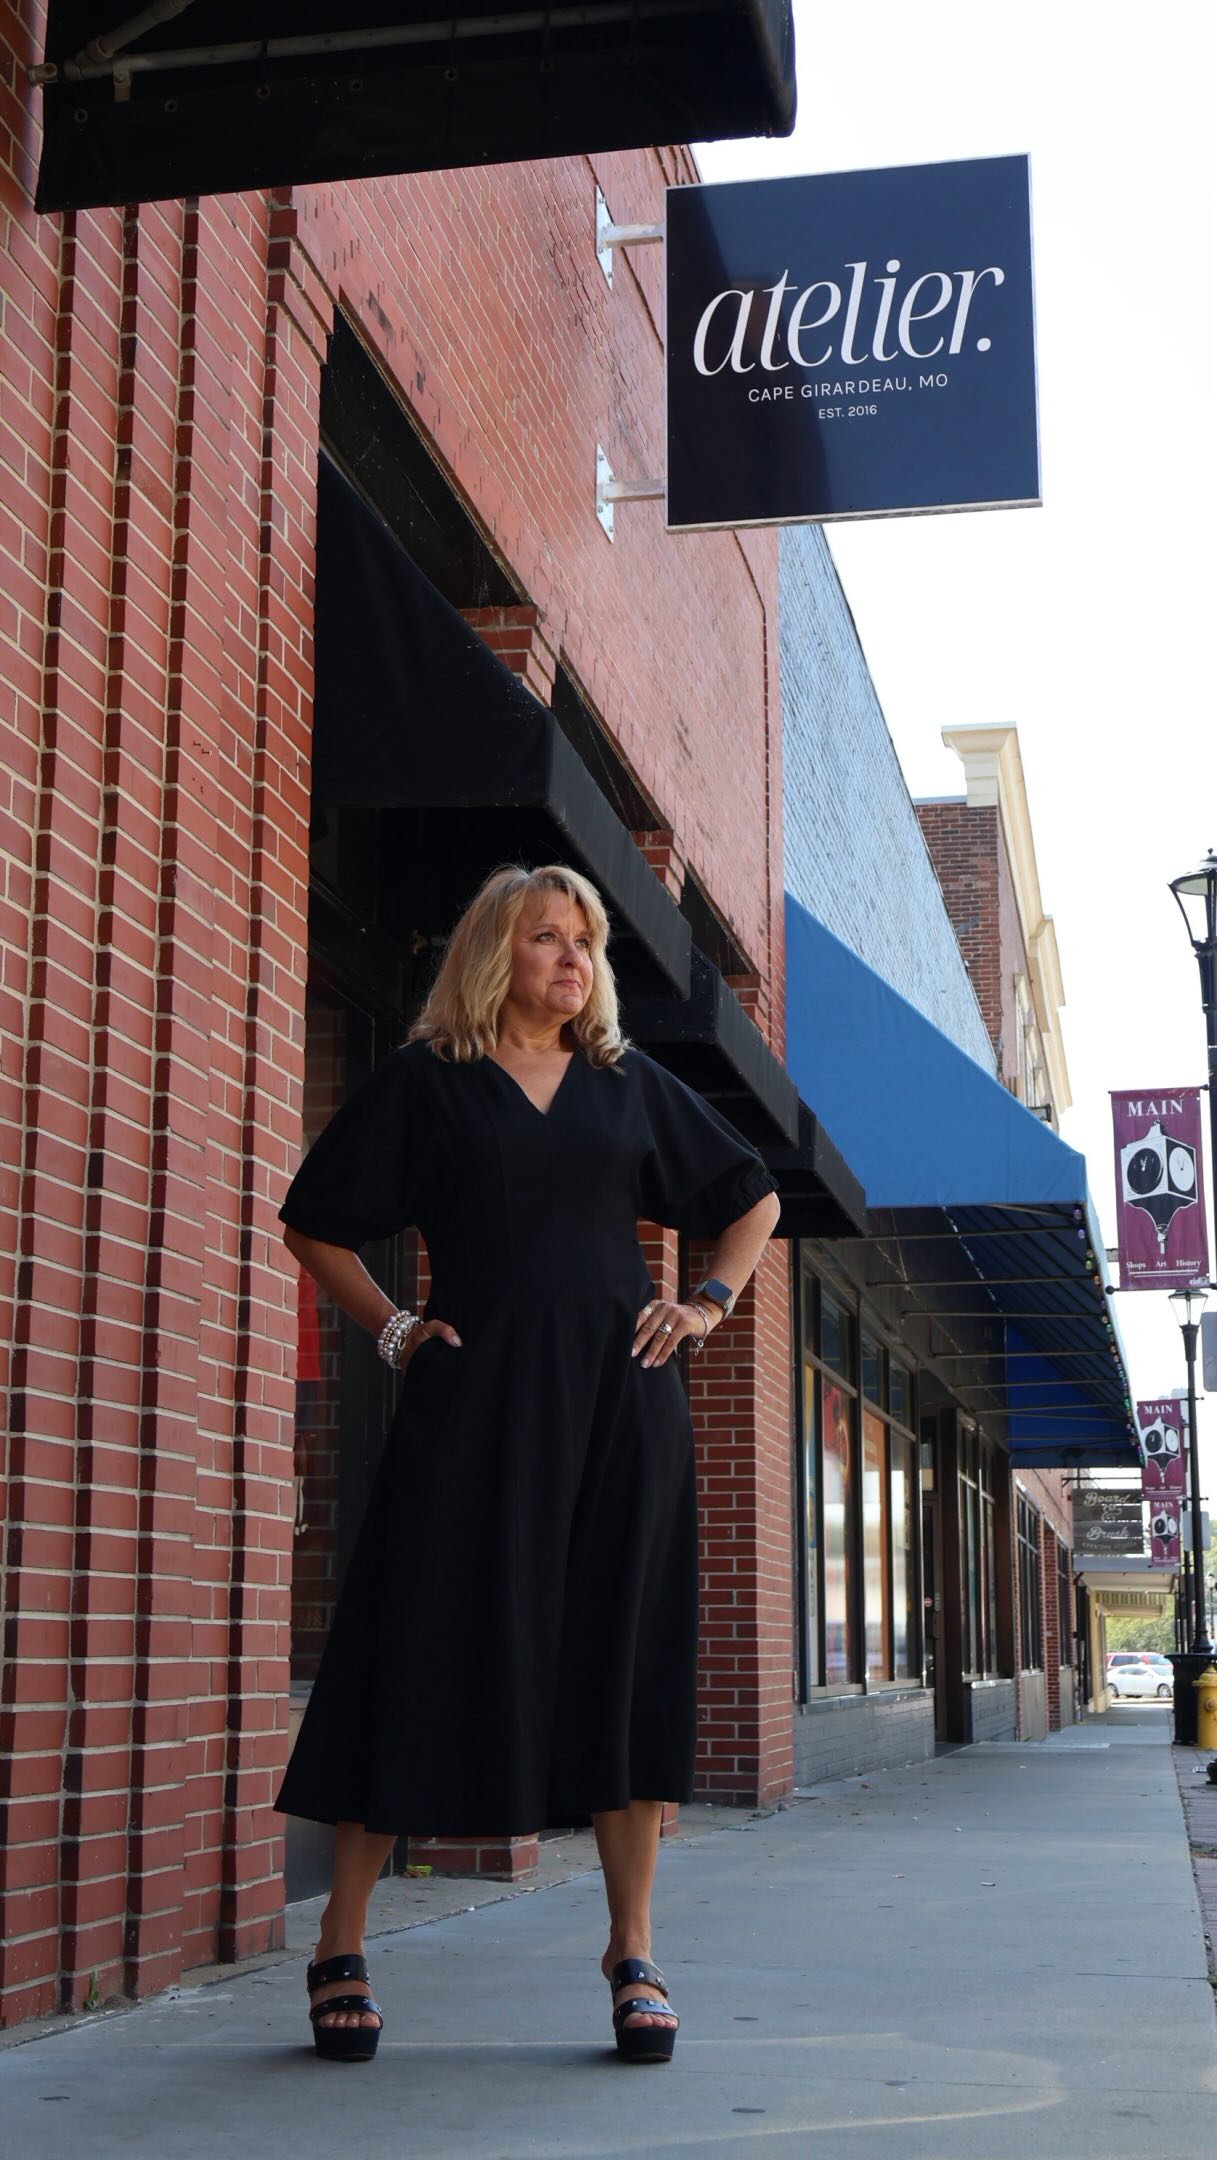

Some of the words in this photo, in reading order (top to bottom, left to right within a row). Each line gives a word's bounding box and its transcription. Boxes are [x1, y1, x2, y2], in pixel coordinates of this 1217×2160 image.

[693, 259, 1005, 377] atelier.
[748, 385, 794, 402] CAPE
[800, 376, 912, 398] GIRARDEAU,
[919, 373, 949, 389] MO
[818, 407, 845, 419] EST.
[847, 404, 878, 417] 2016
[1127, 1099, 1184, 1117] MAIN
[1126, 1261, 1146, 1270] Shops
[1176, 1259, 1201, 1268] History
[1143, 1404, 1173, 1415] MAIN
[1083, 1492, 1131, 1506] Board
[1101, 1504, 1122, 1522] &
[1086, 1526, 1129, 1540] Brush
